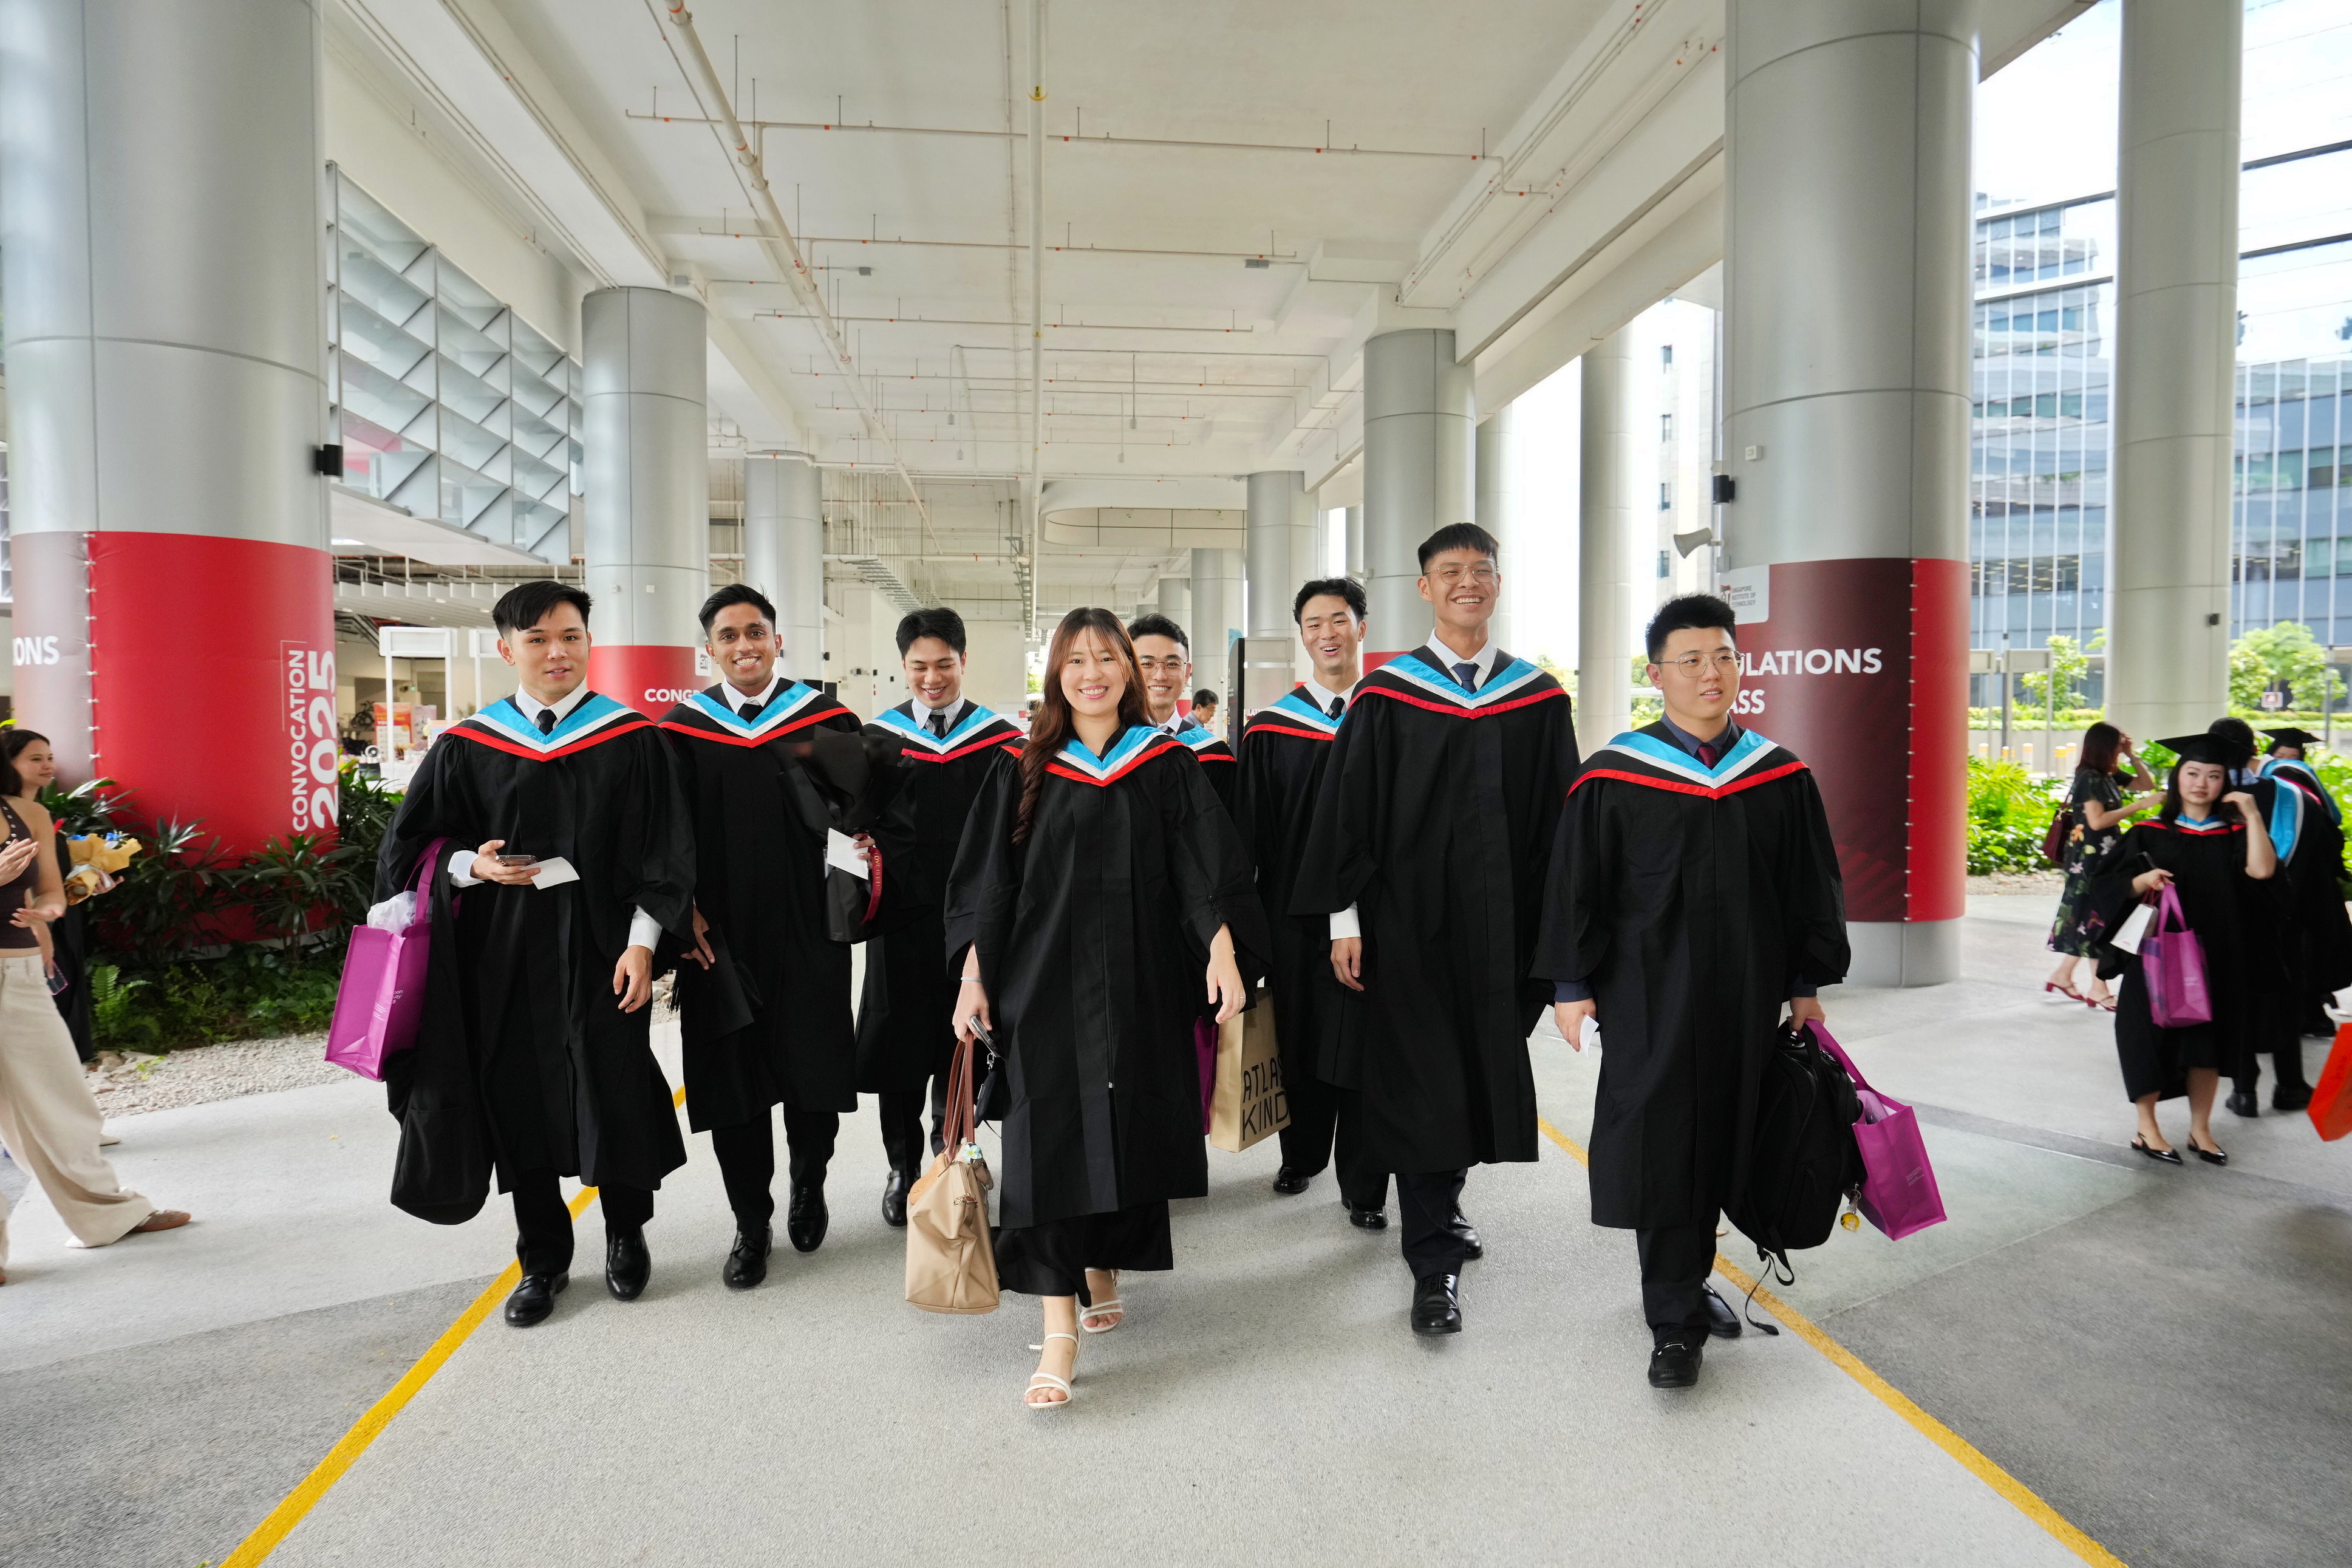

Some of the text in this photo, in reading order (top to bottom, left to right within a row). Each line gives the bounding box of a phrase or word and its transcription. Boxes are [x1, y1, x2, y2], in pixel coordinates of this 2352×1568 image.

[288, 650, 308, 831] CONVOCATION
[308, 650, 339, 829] 2025
[1242, 1091, 1288, 1141] KIND
